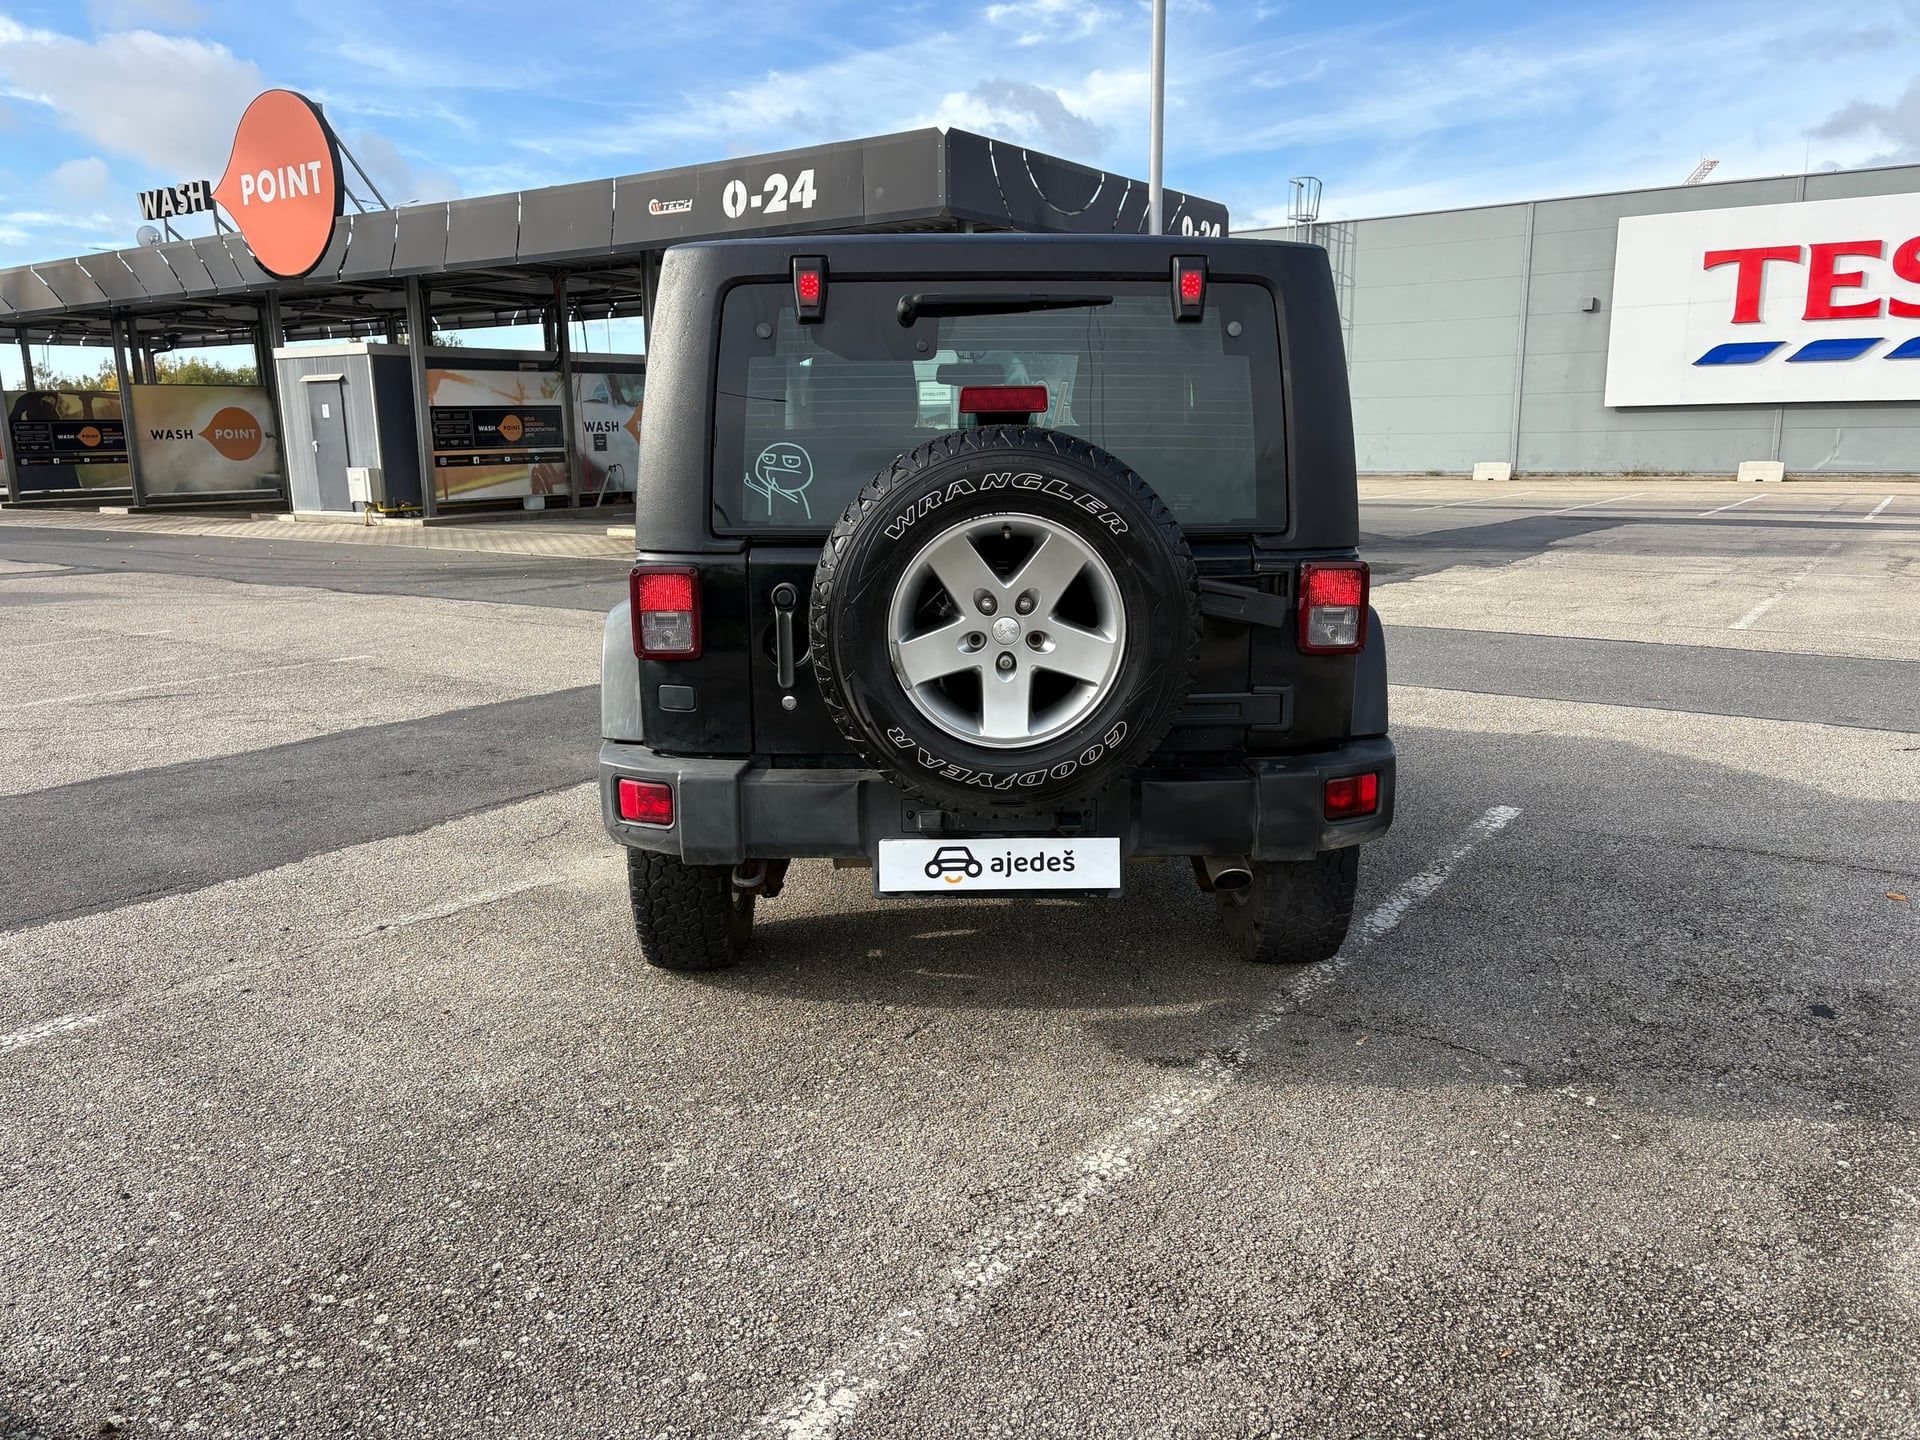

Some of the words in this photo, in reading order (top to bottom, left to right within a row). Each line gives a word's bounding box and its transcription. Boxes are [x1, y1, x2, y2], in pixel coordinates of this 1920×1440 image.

[136, 180, 210, 220] WASH
[240, 160, 322, 206] POINT
[722, 168, 817, 219] 0-24
[150, 429, 194, 440] WASH
[215, 428, 257, 440] POINT
[584, 421, 620, 433] WASH
[884, 472, 1129, 540] WRANGLER
[887, 720, 1128, 790] GOODYEAR
[990, 849, 1076, 877] ajedeš
